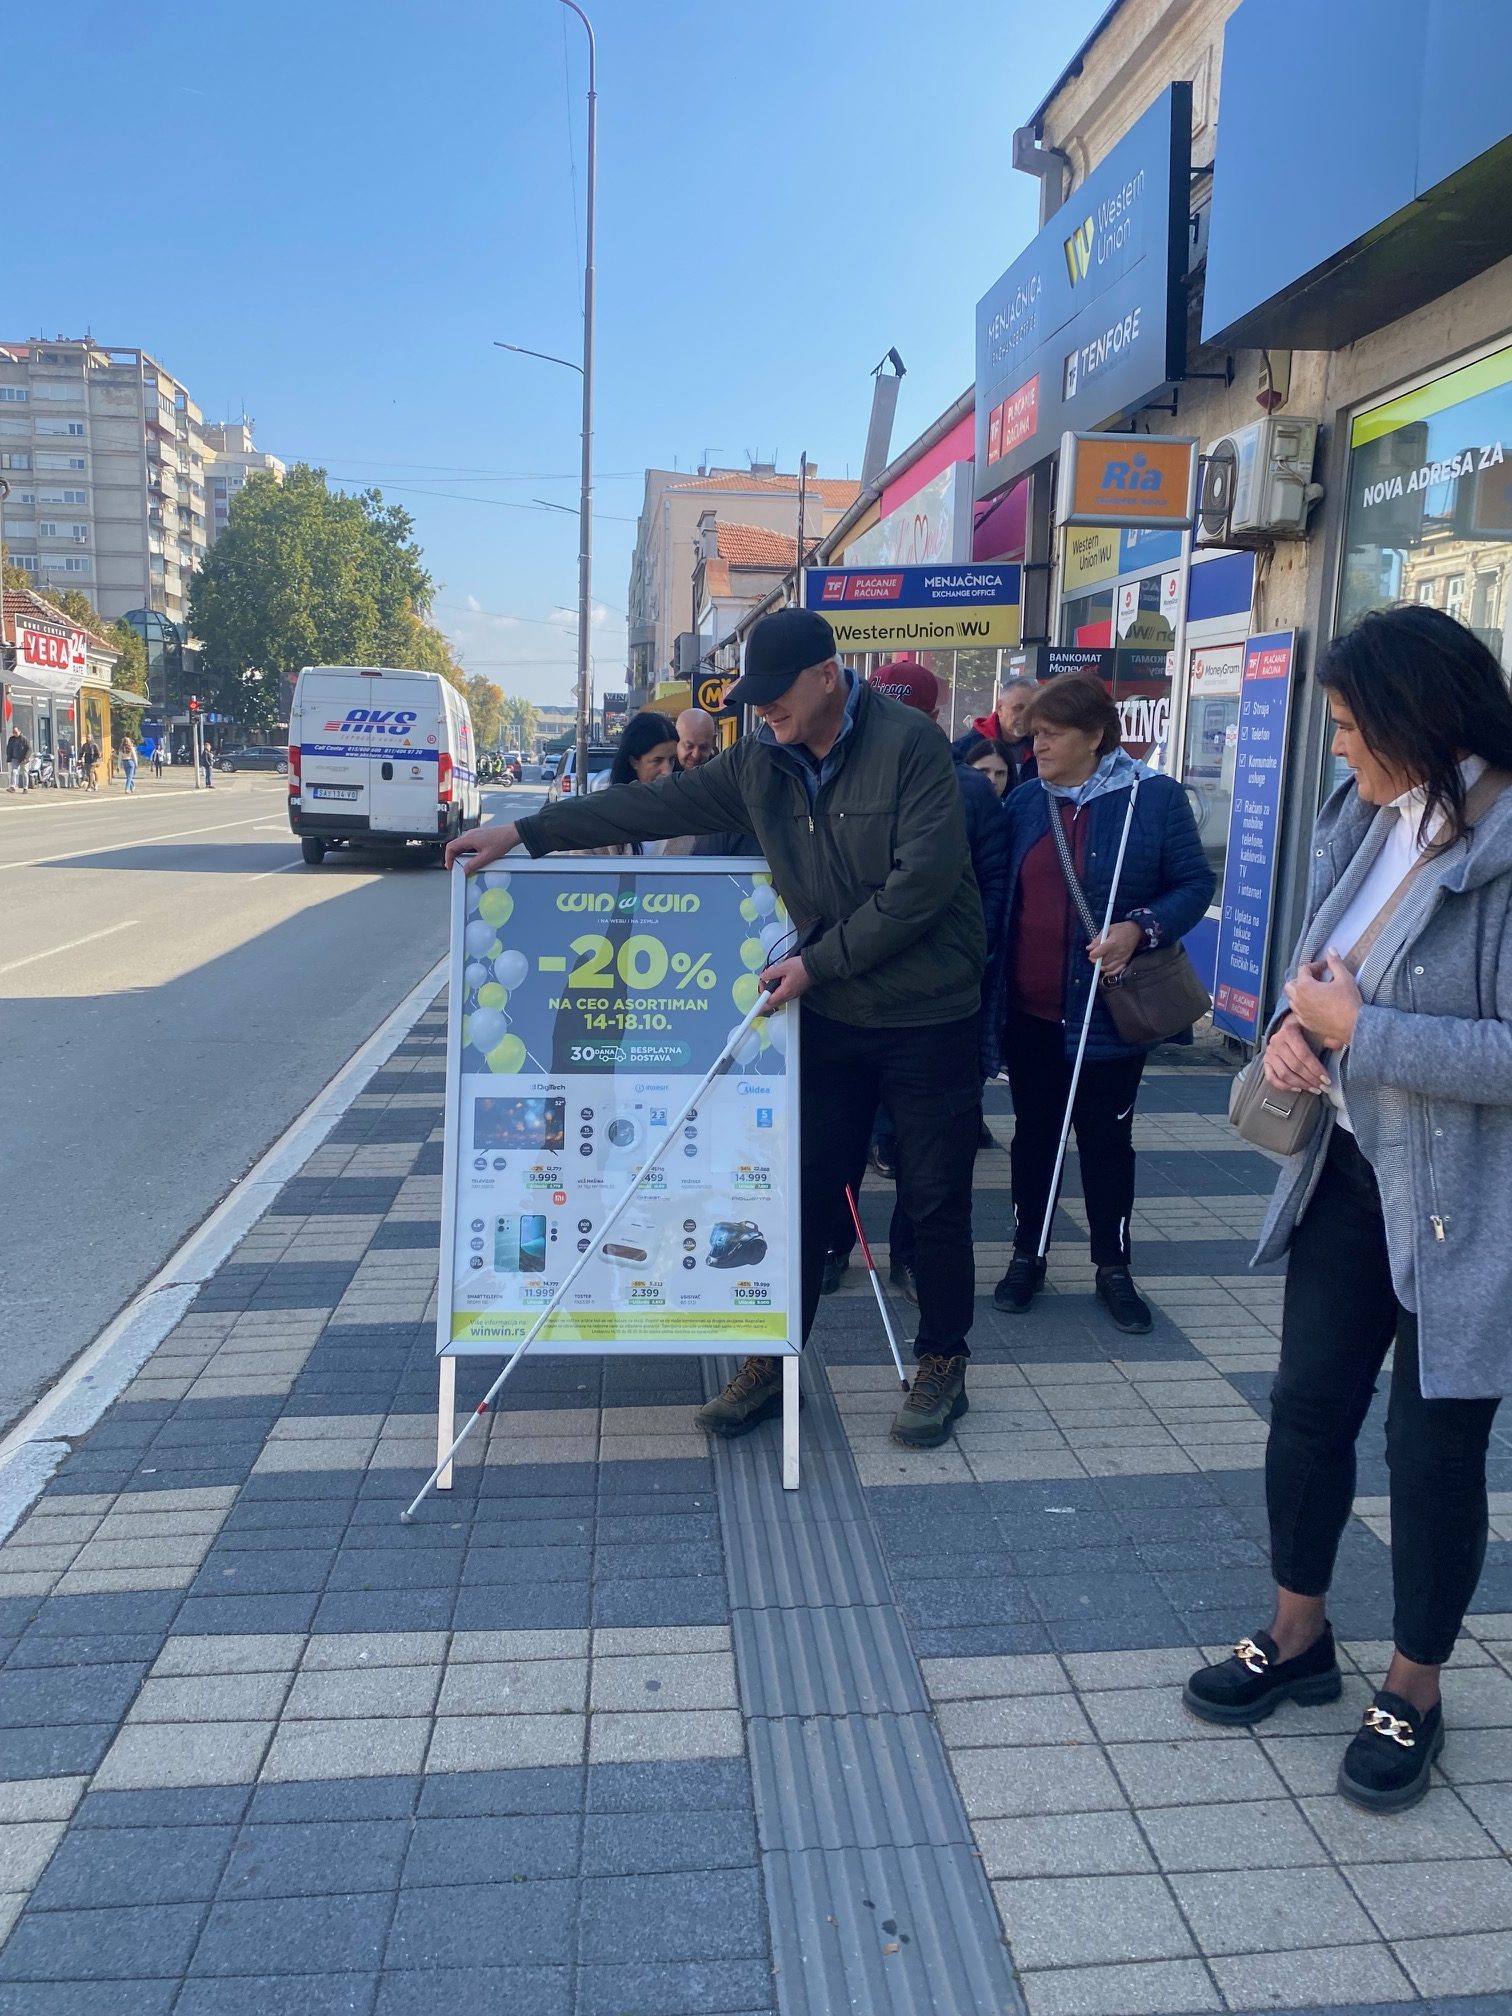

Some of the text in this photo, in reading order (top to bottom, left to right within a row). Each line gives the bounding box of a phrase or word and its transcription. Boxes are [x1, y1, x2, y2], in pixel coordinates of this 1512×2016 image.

[1097, 169, 1145, 233] Western
[1097, 218, 1131, 265] Union
[988, 272, 1042, 346] MENJAČNICA
[1081, 305, 1141, 377] TENFORE
[1101, 451, 1164, 491] Ria
[1363, 441, 1504, 508] NOVA ADRESA ZA
[1072, 535, 1099, 555] Western
[1079, 551, 1098, 571] Union
[828, 581, 842, 592] TF
[856, 578, 897, 588] PLAĆANJE
[924, 573, 1003, 589] MENJAČNICA
[854, 588, 890, 598] RAČUNA
[932, 589, 996, 598] EXCHANGE OFFICE
[834, 622, 954, 641] WesternUnion
[26, 634, 69, 665] VERA
[71, 632, 87, 659] 24
[1049, 653, 1102, 663] BANKOMAT
[1249, 658, 1257, 669] TF
[1205, 664, 1240, 678] MoneyGram
[1253, 702, 1270, 717] Struja
[340, 709, 417, 736] AKS
[1251, 727, 1270, 741] Telefon
[1239, 864, 1247, 879] TV
[538, 934, 717, 990] -20%
[548, 998, 709, 1011] NA CEO ASORTIMAN
[583, 1013, 673, 1030] 14-18.10.
[570, 1046, 595, 1061] 30
[630, 1046, 682, 1054] BESPLATNA
[630, 1054, 671, 1062] DOSTAVA
[761, 1110, 768, 1118] 5
[529, 1173, 557, 1182] 9.999
[735, 1173, 767, 1182] 14.999
[524, 1289, 555, 1297] 11.999
[631, 1289, 659, 1298] 2.399
[734, 1289, 768, 1298] 10.999
[471, 1325, 526, 1337] winwin.rs
